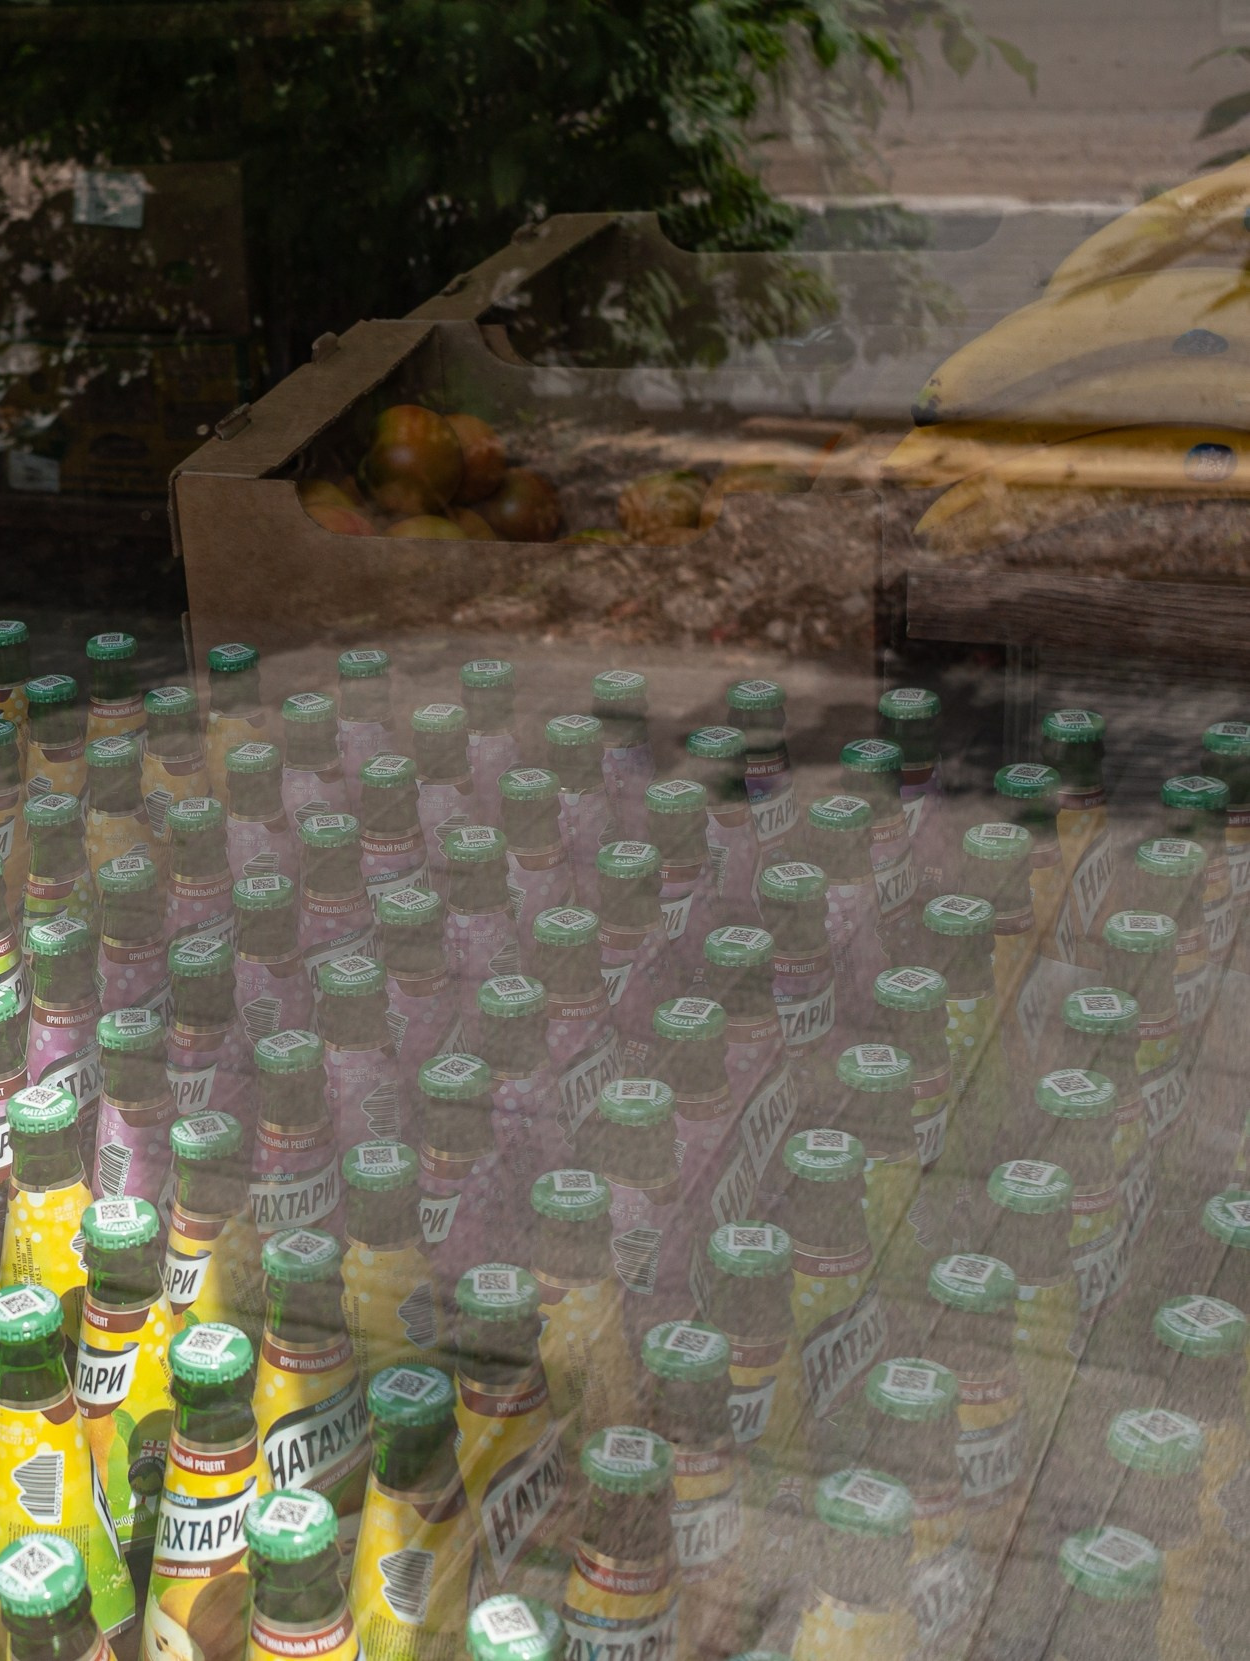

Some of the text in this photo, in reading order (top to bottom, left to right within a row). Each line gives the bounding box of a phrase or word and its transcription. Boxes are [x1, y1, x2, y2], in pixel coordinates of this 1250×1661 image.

[394, 841, 414, 852] РЕЦЕПТ
[29, 885, 46, 896] РЕЦЕПТ
[791, 962, 815, 974] РЕЦЕПТ
[174, 1038, 192, 1048] РЕЦЕПТ
[291, 1137, 315, 1149] РЕЦЕПТ
[87, 1314, 108, 1327] РЕЦЕПТ
[280, 1351, 341, 1369] ОРИГИНАЛЬНЫЙ
[195, 1459, 226, 1472] РЕЦЕПТ
[178, 1566, 211, 1578] ЛИМОНАД
